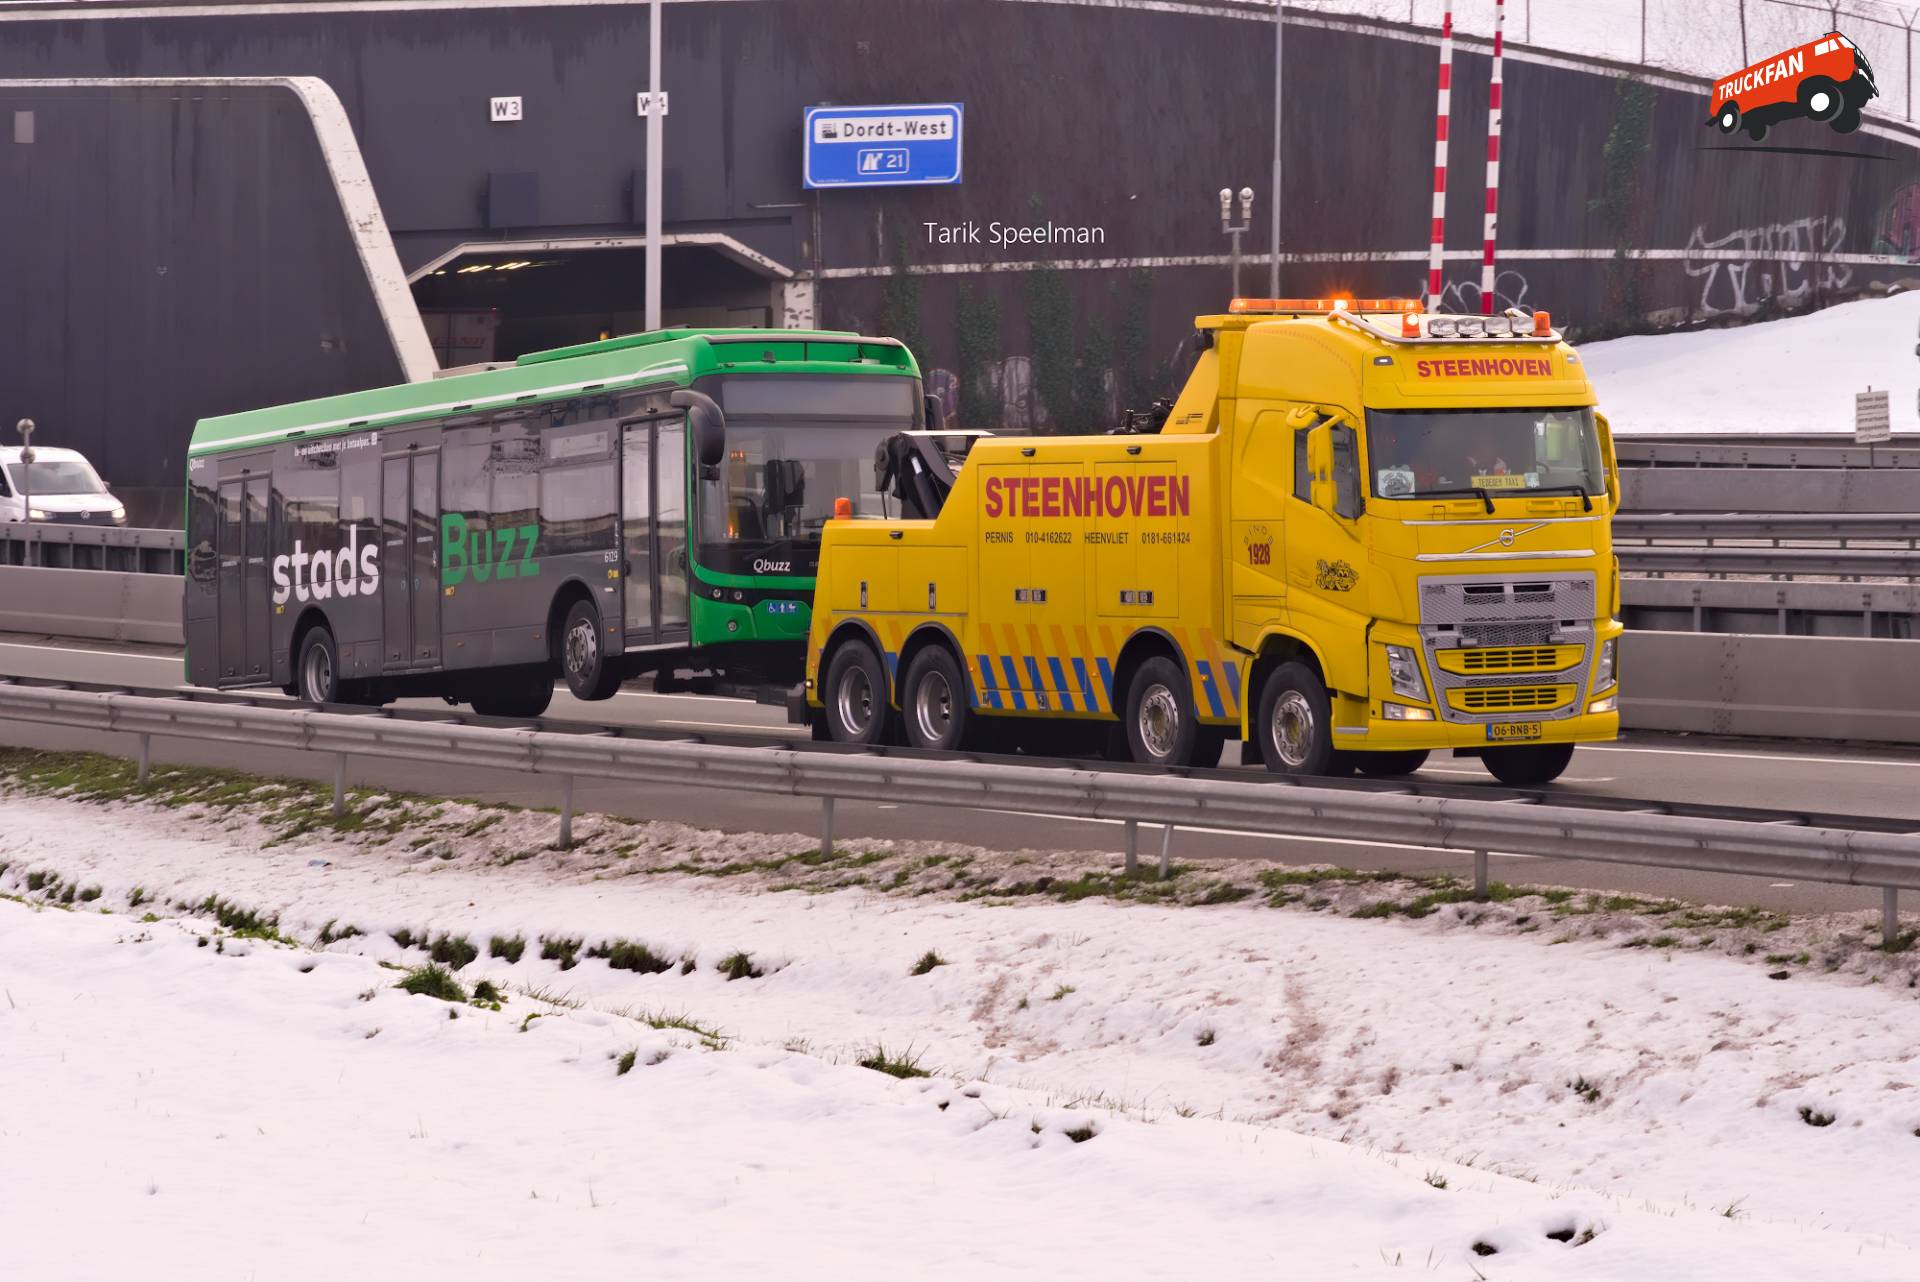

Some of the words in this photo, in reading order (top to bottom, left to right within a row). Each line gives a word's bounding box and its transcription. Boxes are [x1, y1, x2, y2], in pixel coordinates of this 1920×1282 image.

[843, 121, 947, 138] Dordt-West
[886, 154, 904, 168] 21
[1417, 358, 1553, 378] STEENHOVEN
[985, 475, 1190, 518] STEENHOVEN
[985, 532, 1014, 543] PERNIS
[1025, 532, 1072, 543] 010-4162622
[1084, 532, 1129, 544] HEENVLIET
[1141, 532, 1190, 544] 0181-661424
[272, 523, 379, 605] stads
[441, 513, 540, 586] Buzz
[1248, 543, 1271, 565] 1928
[753, 559, 791, 573] Qbuzz
[1494, 724, 1538, 736] 06-BNB-5
